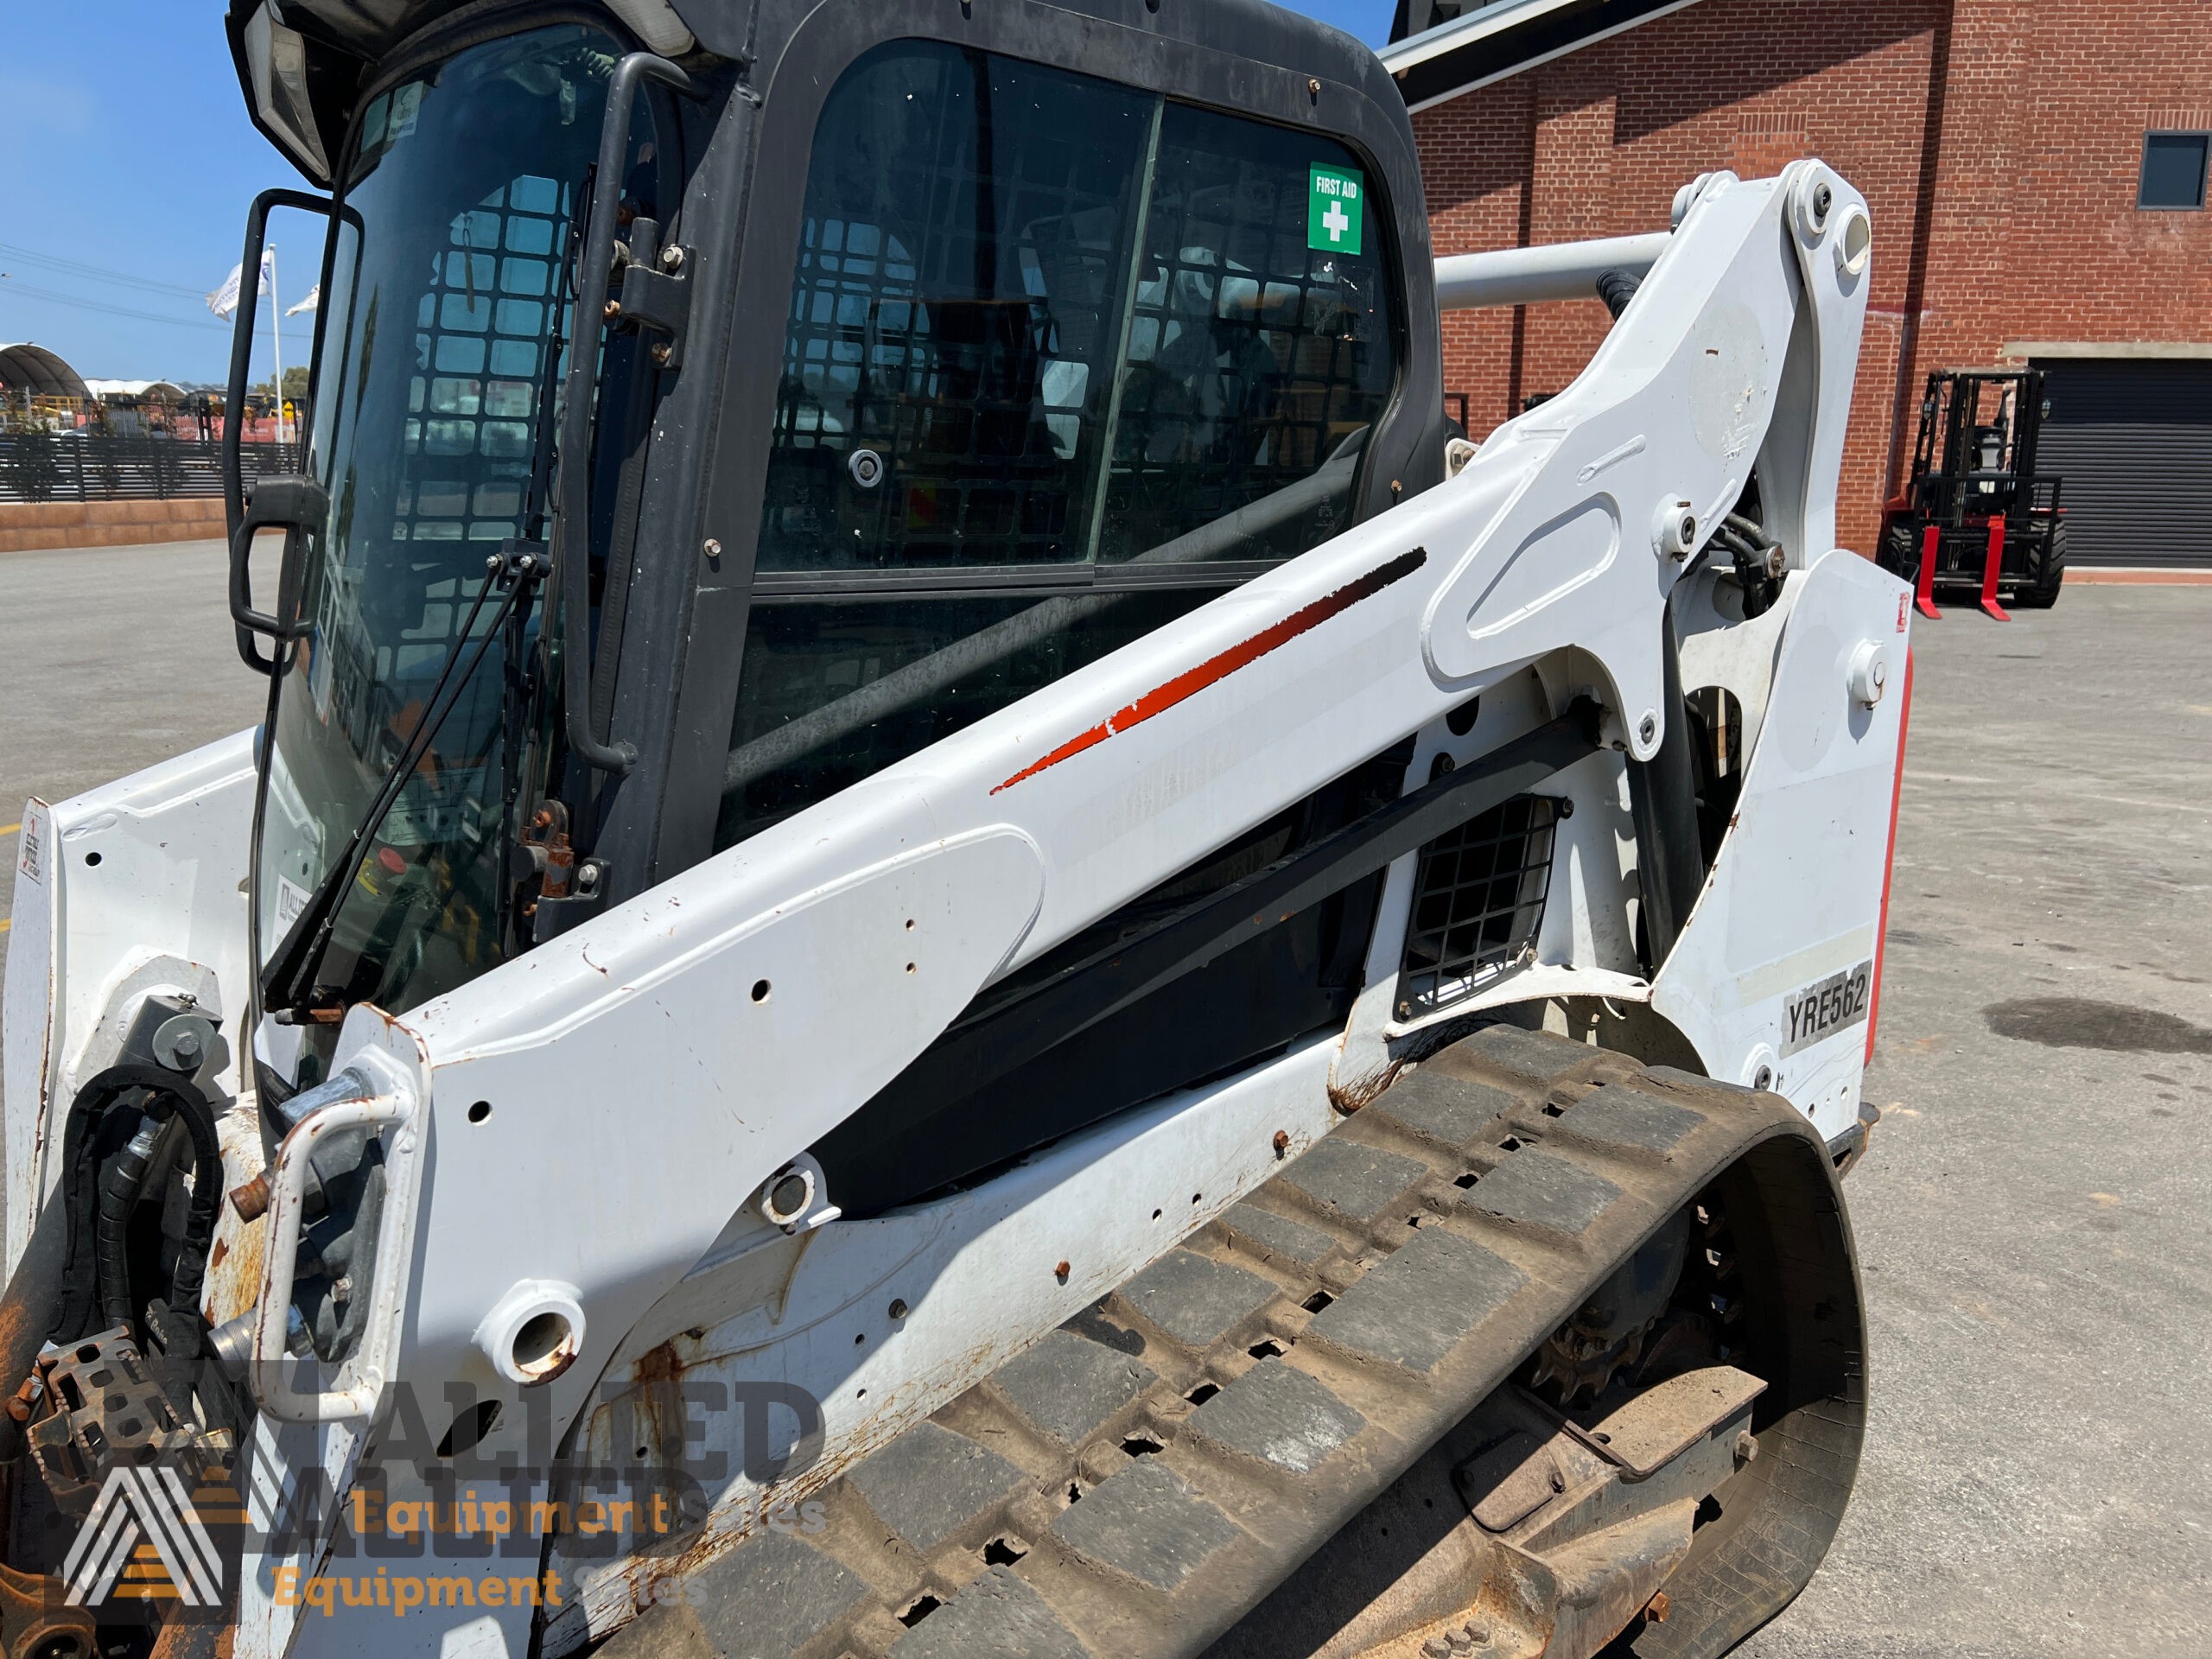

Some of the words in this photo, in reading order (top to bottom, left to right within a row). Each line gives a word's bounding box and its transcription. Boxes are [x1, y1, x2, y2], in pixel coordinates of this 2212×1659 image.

[1316, 176, 1340, 196] FIRST
[1342, 181, 1357, 199] AID
[1789, 974, 1866, 1043] YRE562
